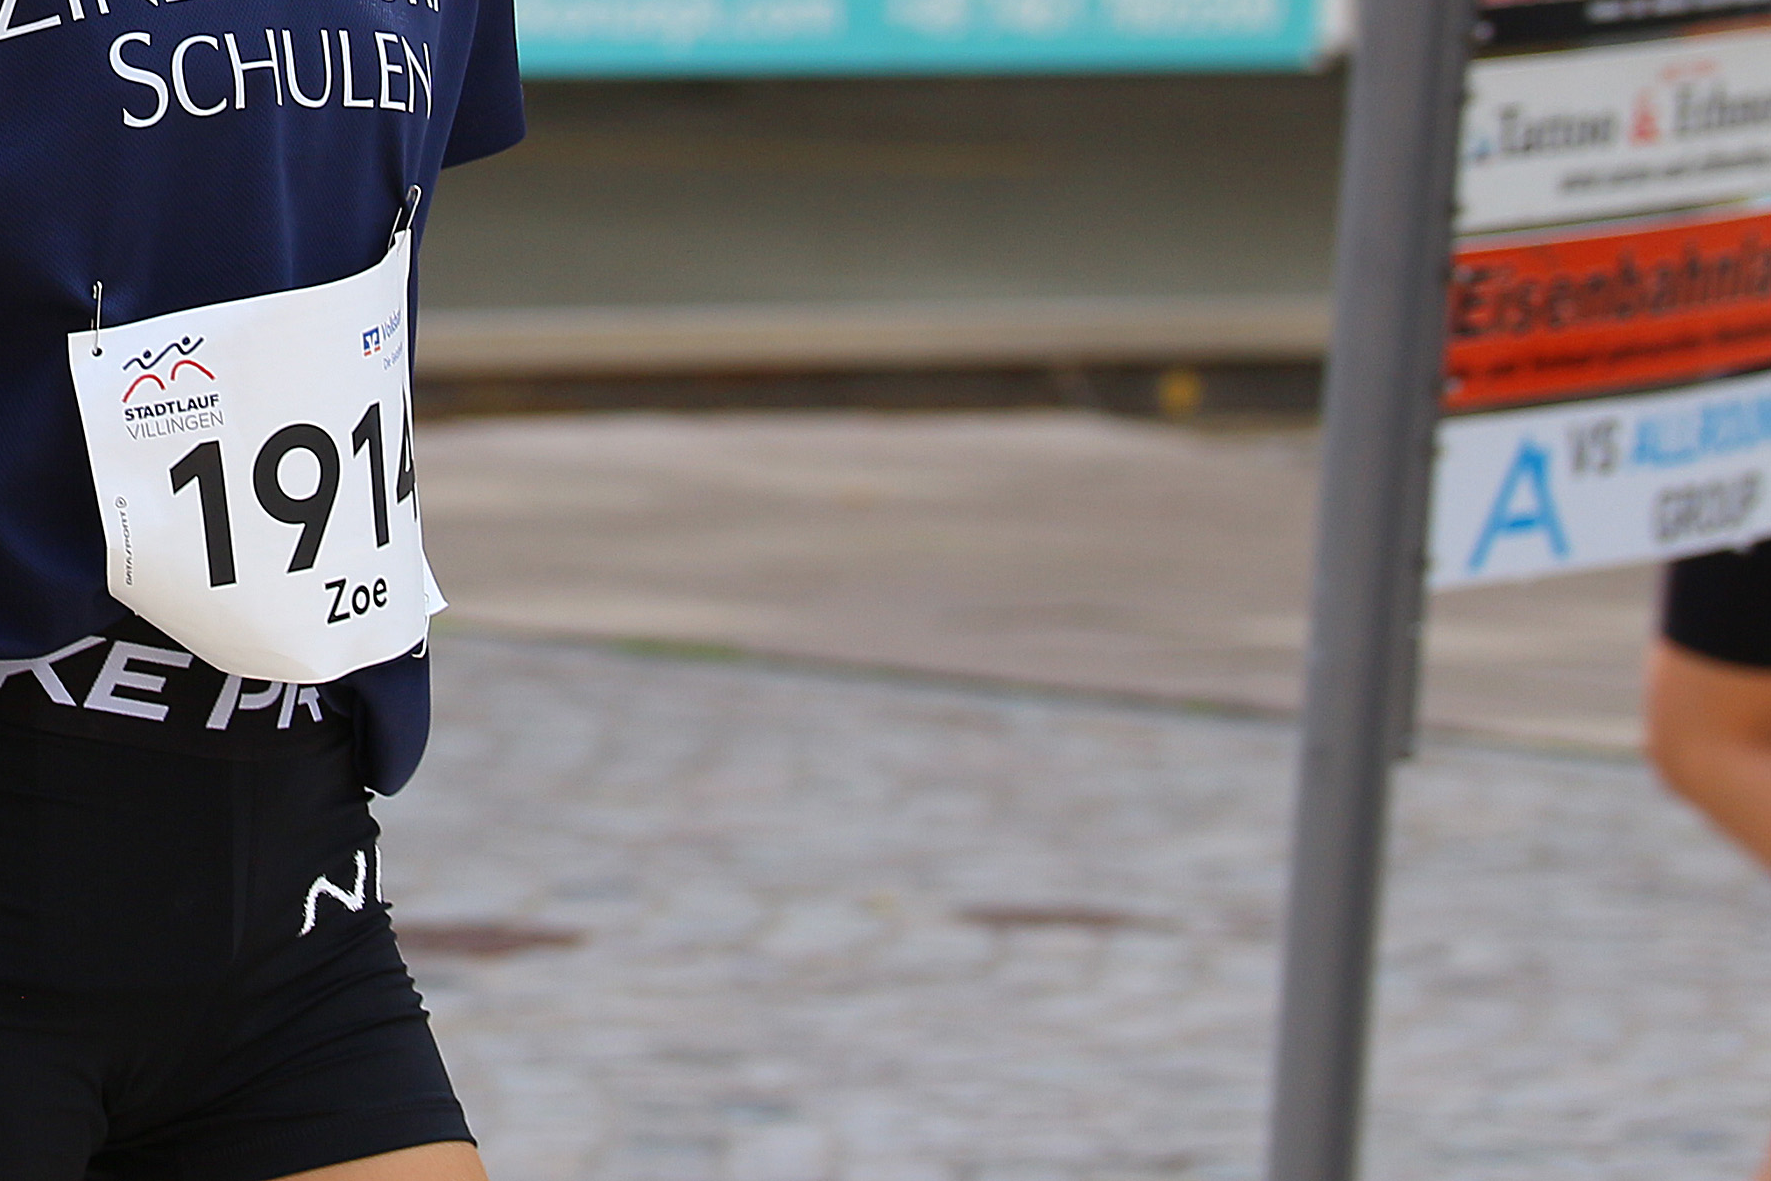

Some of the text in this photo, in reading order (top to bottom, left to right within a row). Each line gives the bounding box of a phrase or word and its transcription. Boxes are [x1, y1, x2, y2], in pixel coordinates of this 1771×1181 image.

[108, 28, 433, 129] SCHULEN
[123, 392, 221, 422] STADTLAUF
[125, 409, 225, 441] VILLINGEN
[169, 400, 418, 589] 1914
[1467, 437, 1571, 573] A
[324, 576, 388, 625] Zoe
